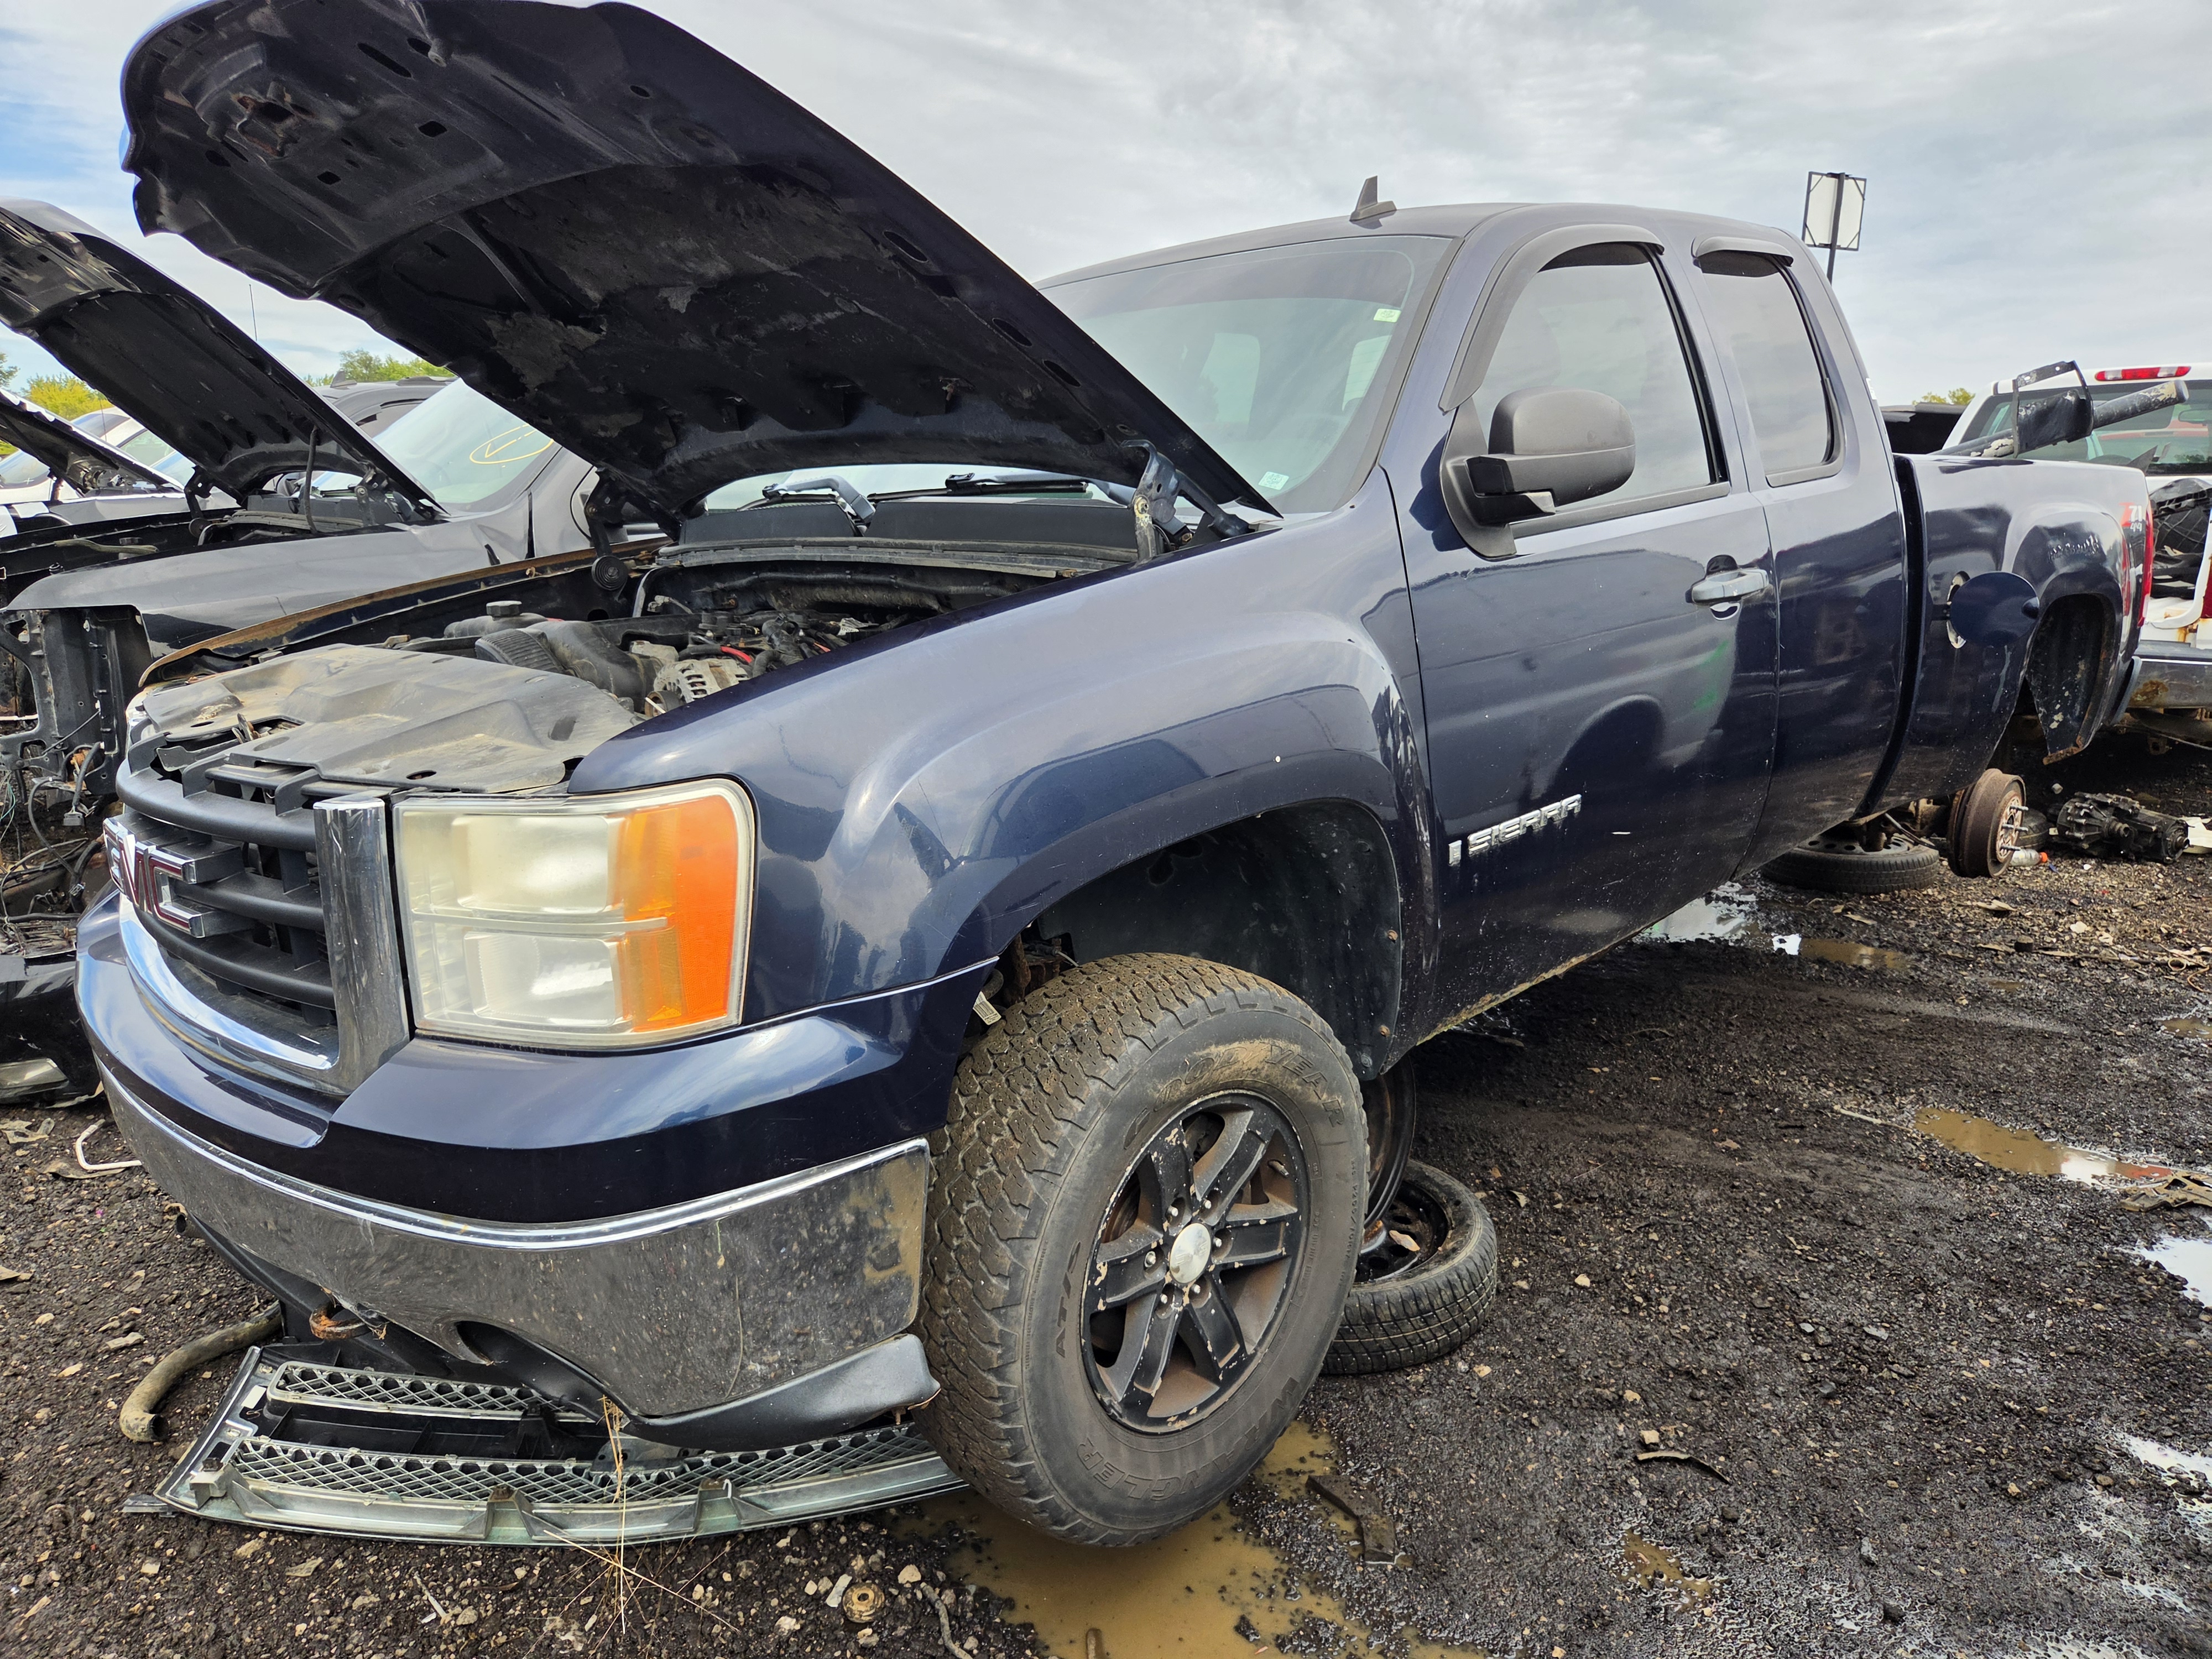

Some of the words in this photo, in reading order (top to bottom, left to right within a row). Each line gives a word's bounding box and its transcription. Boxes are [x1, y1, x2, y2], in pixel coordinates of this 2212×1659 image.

[2118, 502, 2143, 527] Z71
[103, 817, 206, 938] GMC
[1467, 794, 1582, 856] SIERRA
[1124, 1043, 1347, 1150] GOODYEAR
[1076, 1376, 1300, 1501] WRANGLER
